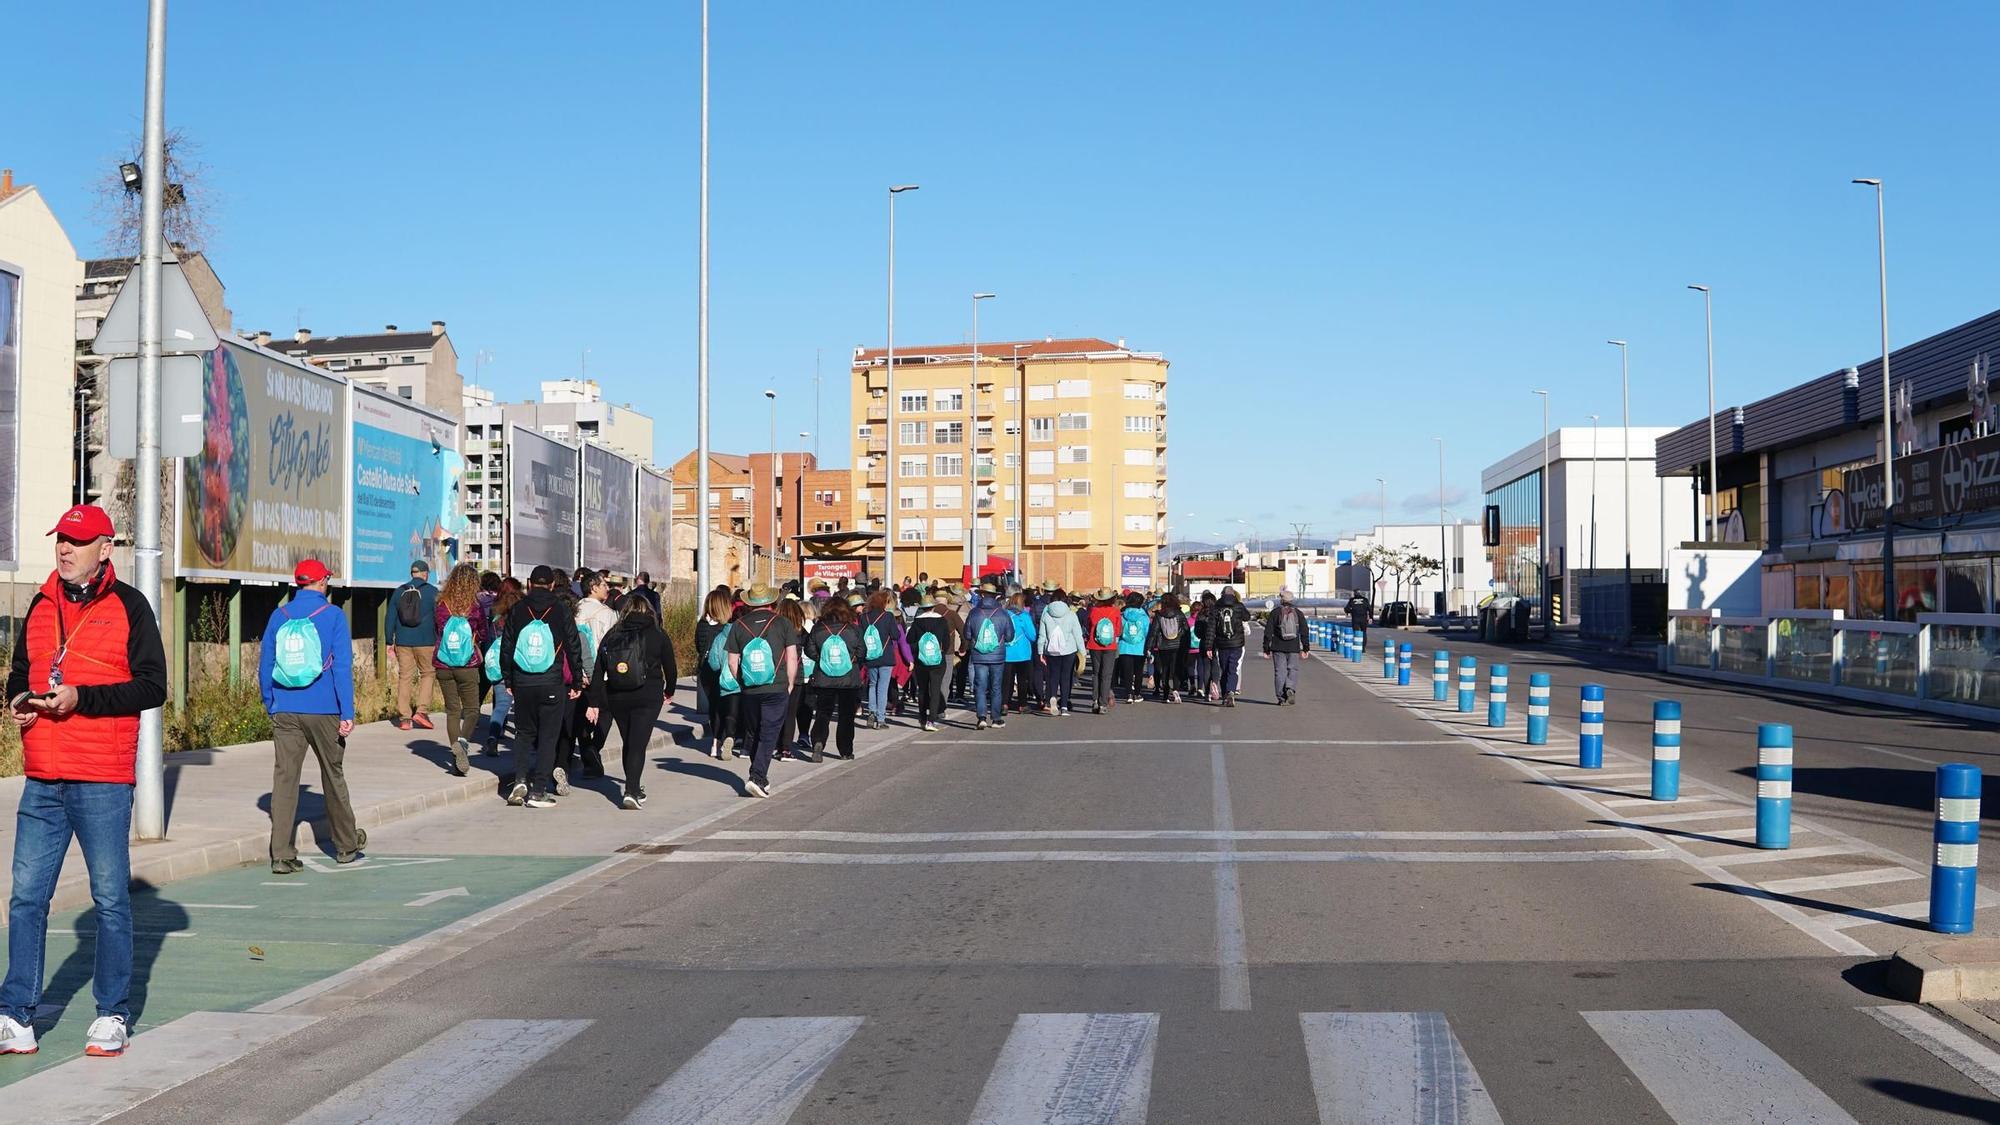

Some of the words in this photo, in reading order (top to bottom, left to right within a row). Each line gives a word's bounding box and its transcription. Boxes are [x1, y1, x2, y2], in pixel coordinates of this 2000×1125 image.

[286, 375, 301, 406] HAS
[303, 379, 333, 416] PROBADO
[1864, 471, 1904, 508] kebb
[253, 499, 264, 532] NO
[264, 502, 280, 532] HAS
[281, 502, 314, 536] PROBADO
